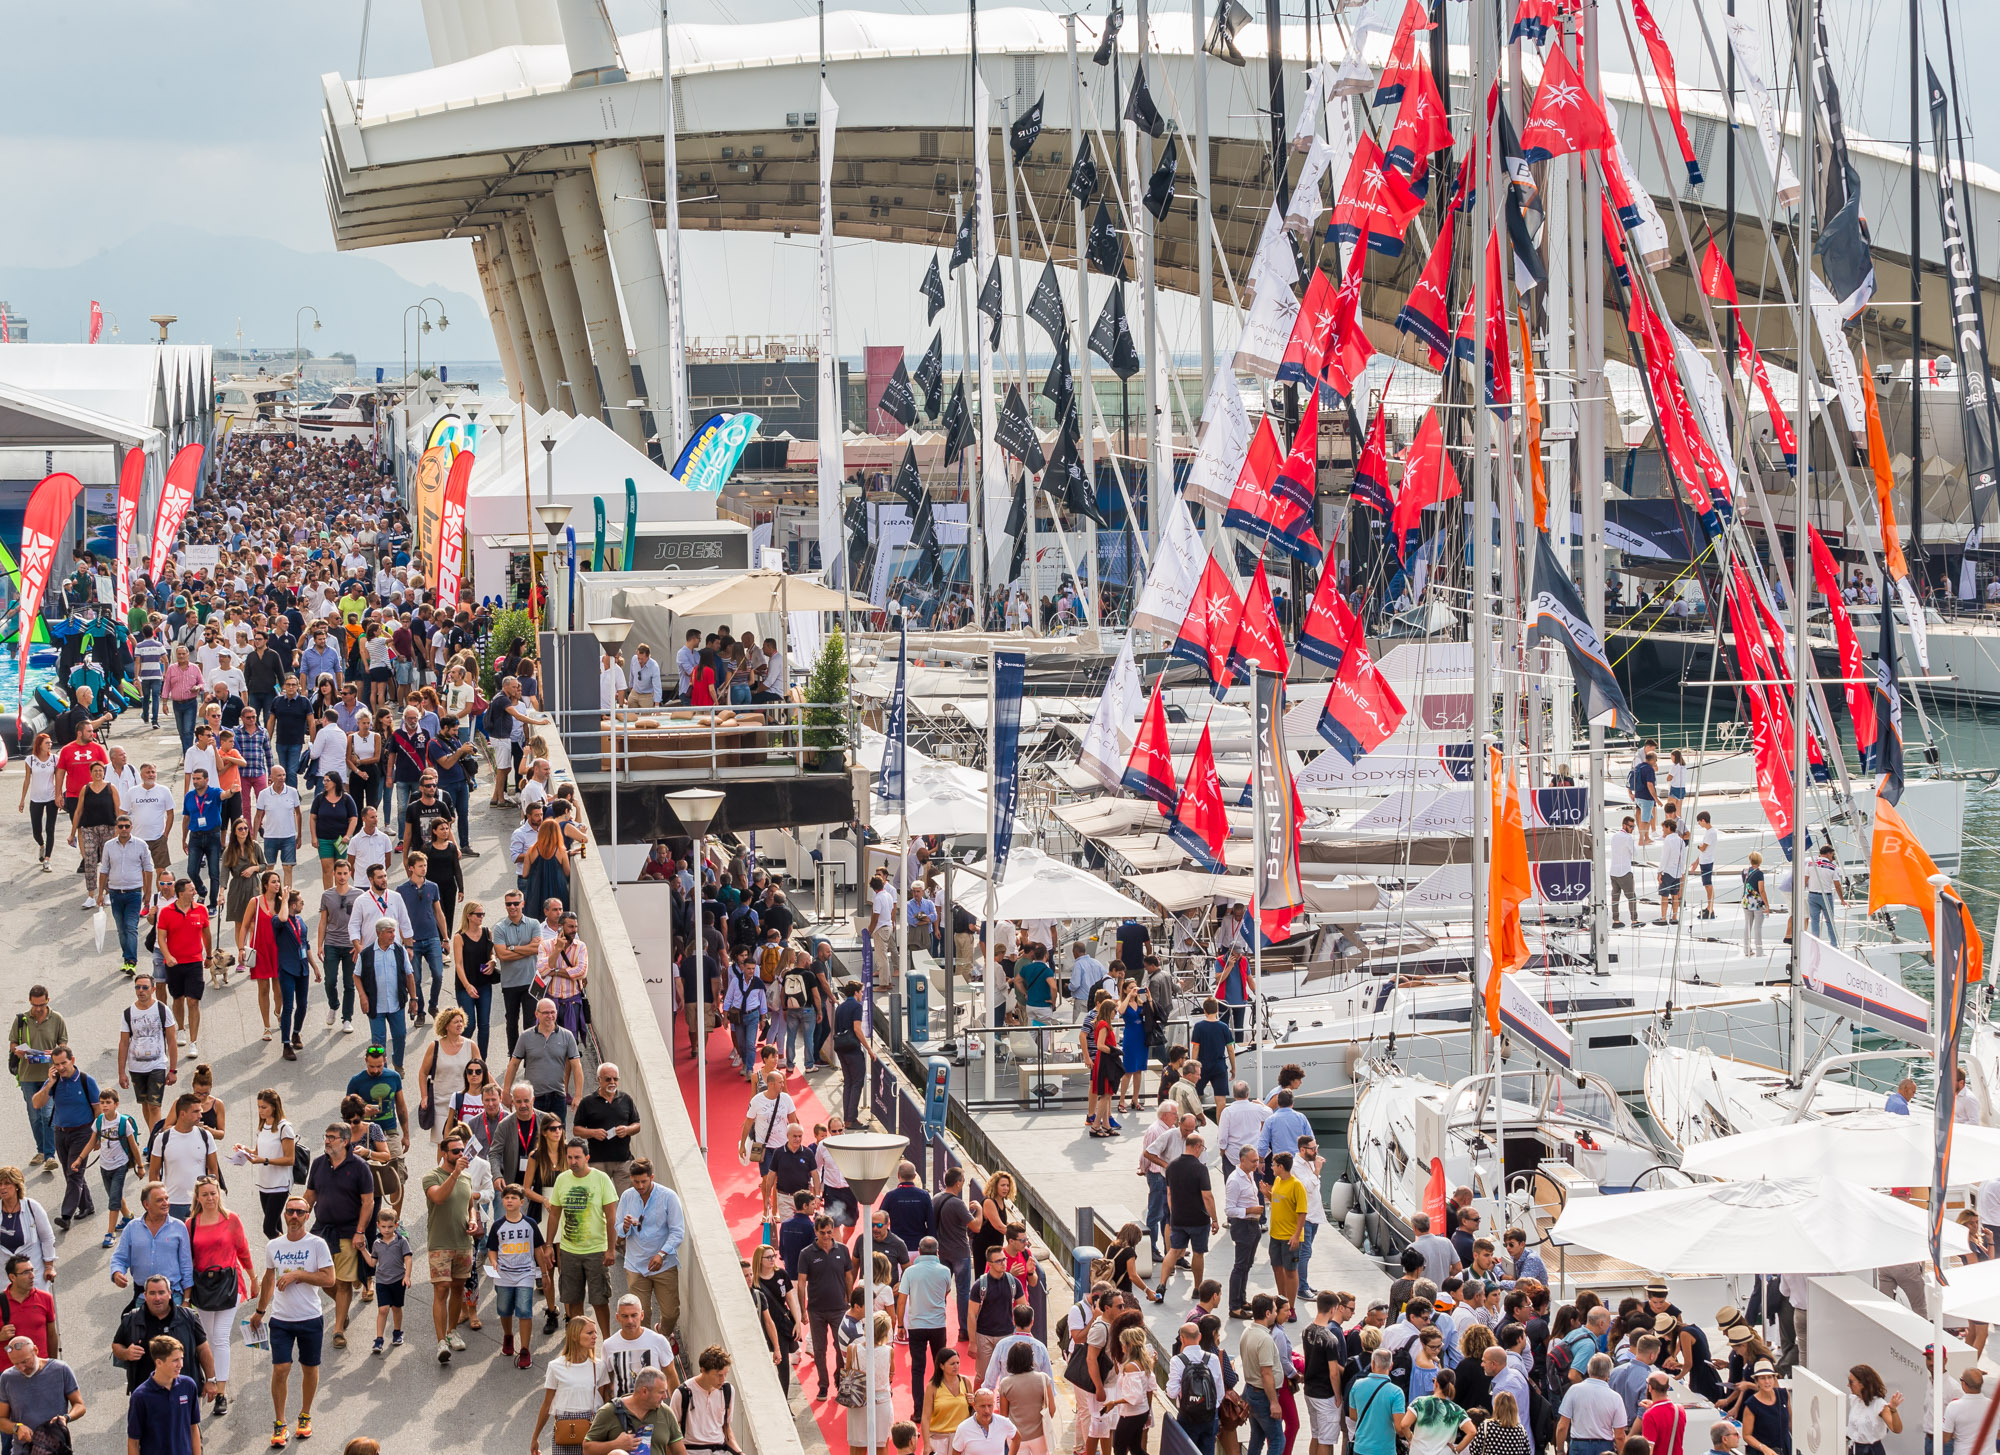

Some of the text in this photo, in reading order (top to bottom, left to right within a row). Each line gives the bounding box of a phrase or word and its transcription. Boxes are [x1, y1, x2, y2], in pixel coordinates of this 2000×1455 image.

[1336, 195, 1393, 217] JEANNE
[685, 346, 819, 356] PIZZERIA LA MARINA
[889, 379, 918, 410] DUFOU
[680, 425, 717, 486] aglide
[1196, 449, 1240, 476] JEANN
[1208, 468, 1237, 487] YACHT
[1236, 479, 1281, 507] JEAN
[1604, 527, 1645, 547] LIUS
[654, 541, 708, 560] JOBE
[1147, 578, 1190, 601] JEAN
[1416, 666, 1474, 674] JEANNE
[1333, 677, 1391, 737] ANNEAU
[1433, 712, 1467, 725] 54
[1305, 768, 1440, 783] SUN ODYSSEY
[1259, 703, 1282, 880] BENETEAU
[1372, 815, 1402, 824] SUN
[1424, 817, 1456, 826] SUN
[1549, 808, 1582, 821] 410
[1420, 892, 1452, 901] SUN
[1550, 883, 1586, 896] 349
[1845, 972, 1874, 994] Oceanis
[500, 1229, 530, 1241] FEEL
[502, 1242, 530, 1254] GOOD
